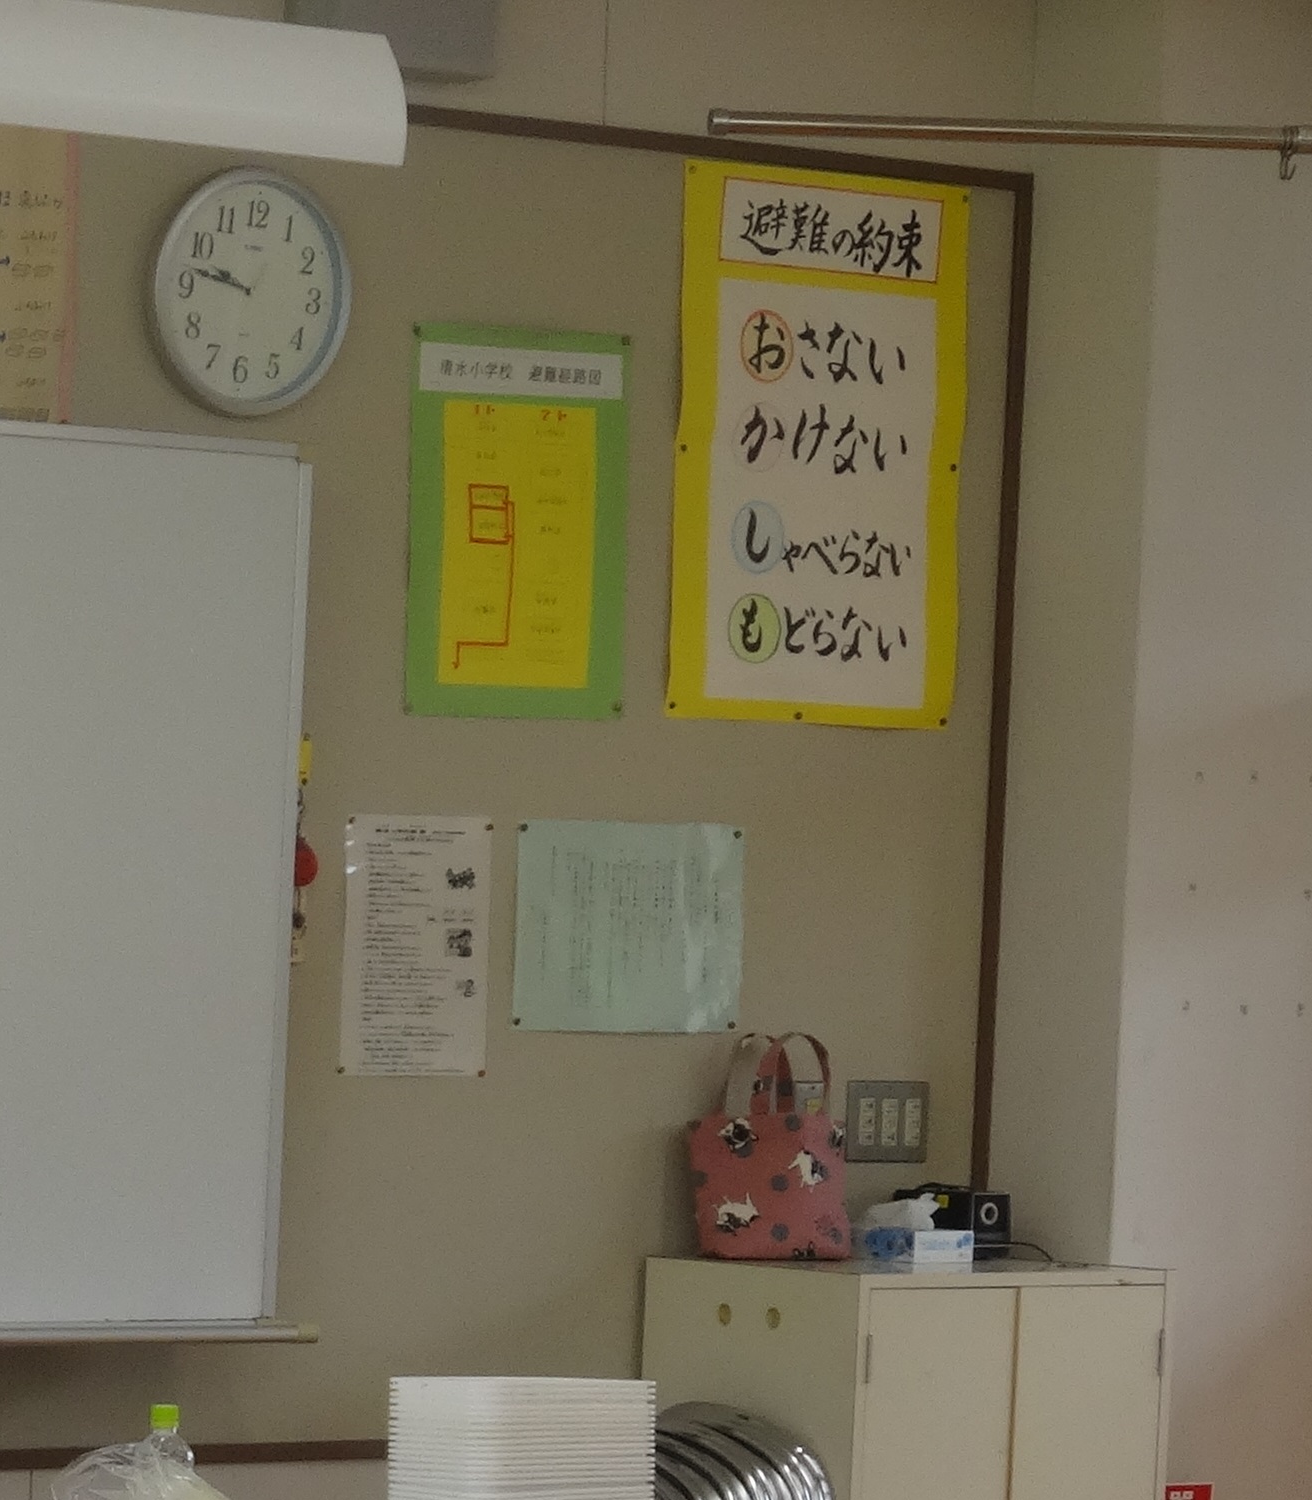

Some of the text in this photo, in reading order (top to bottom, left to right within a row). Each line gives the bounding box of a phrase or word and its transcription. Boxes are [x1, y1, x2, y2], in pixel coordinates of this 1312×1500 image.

[216, 205, 236, 235] 11
[246, 199, 270, 230] 12
[282, 215, 294, 242] 1
[190, 231, 214, 260] 10
[739, 199, 924, 278] 避難の約束
[300, 246, 315, 275] 2
[178, 270, 195, 299] 9
[305, 287, 321, 315] 3
[184, 311, 201, 340] 8
[289, 326, 304, 351] 4
[205, 343, 221, 370] 7
[745, 312, 907, 386] おさない
[232, 355, 249, 384] 6
[265, 352, 281, 379] 5
[739, 404, 908, 475] かけない
[743, 506, 913, 579] しゃべらない
[738, 597, 908, 662] もどらない
